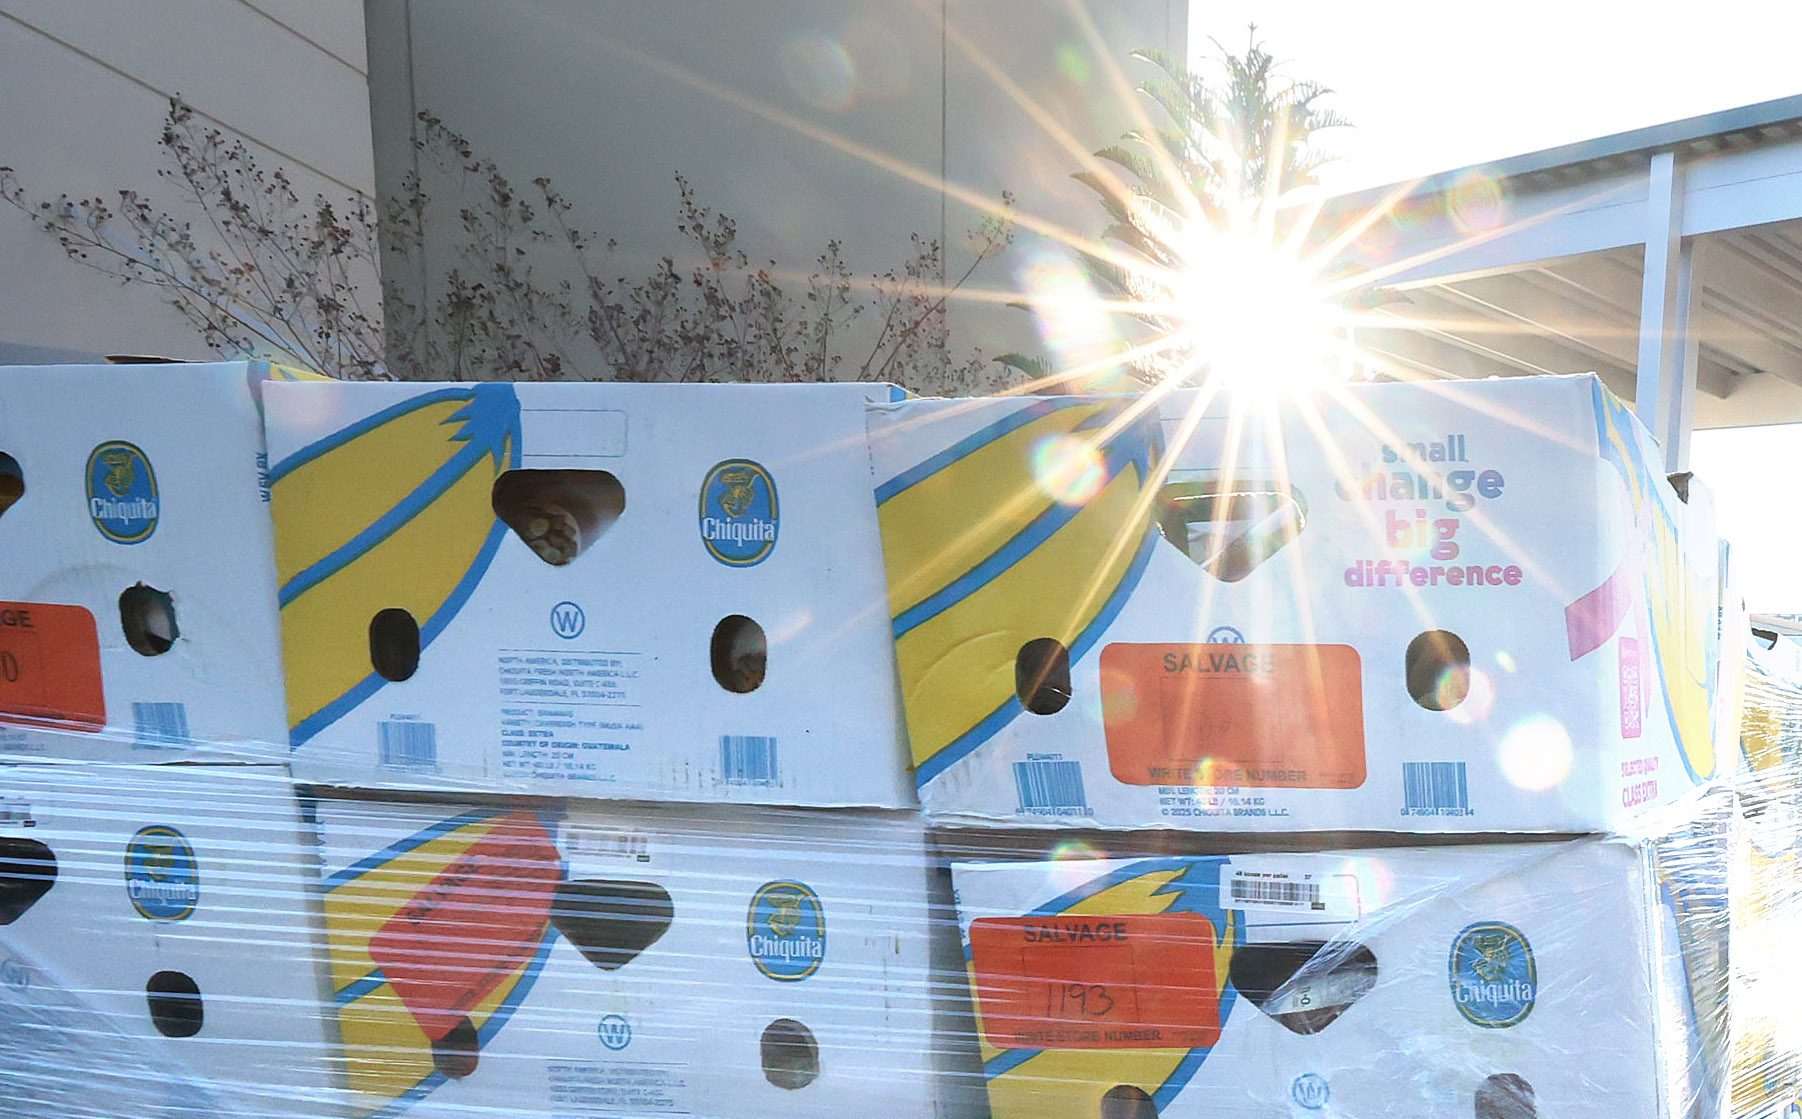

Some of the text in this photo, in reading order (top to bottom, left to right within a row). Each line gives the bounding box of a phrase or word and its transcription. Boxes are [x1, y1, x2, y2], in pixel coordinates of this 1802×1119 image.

[90, 497, 157, 525] Chiquita
[702, 517, 776, 547] Chiquita
[1385, 508, 1460, 561] big
[1344, 559, 1523, 587] difference
[1163, 653, 1277, 673] SALVAGE
[1246, 768, 1307, 782] NUMBER
[1023, 922, 1128, 943] SALVAGE
[750, 934, 821, 963] Chiquita
[1454, 981, 1531, 1008] Chiquita
[1103, 1029, 1162, 1042] NUMBER
